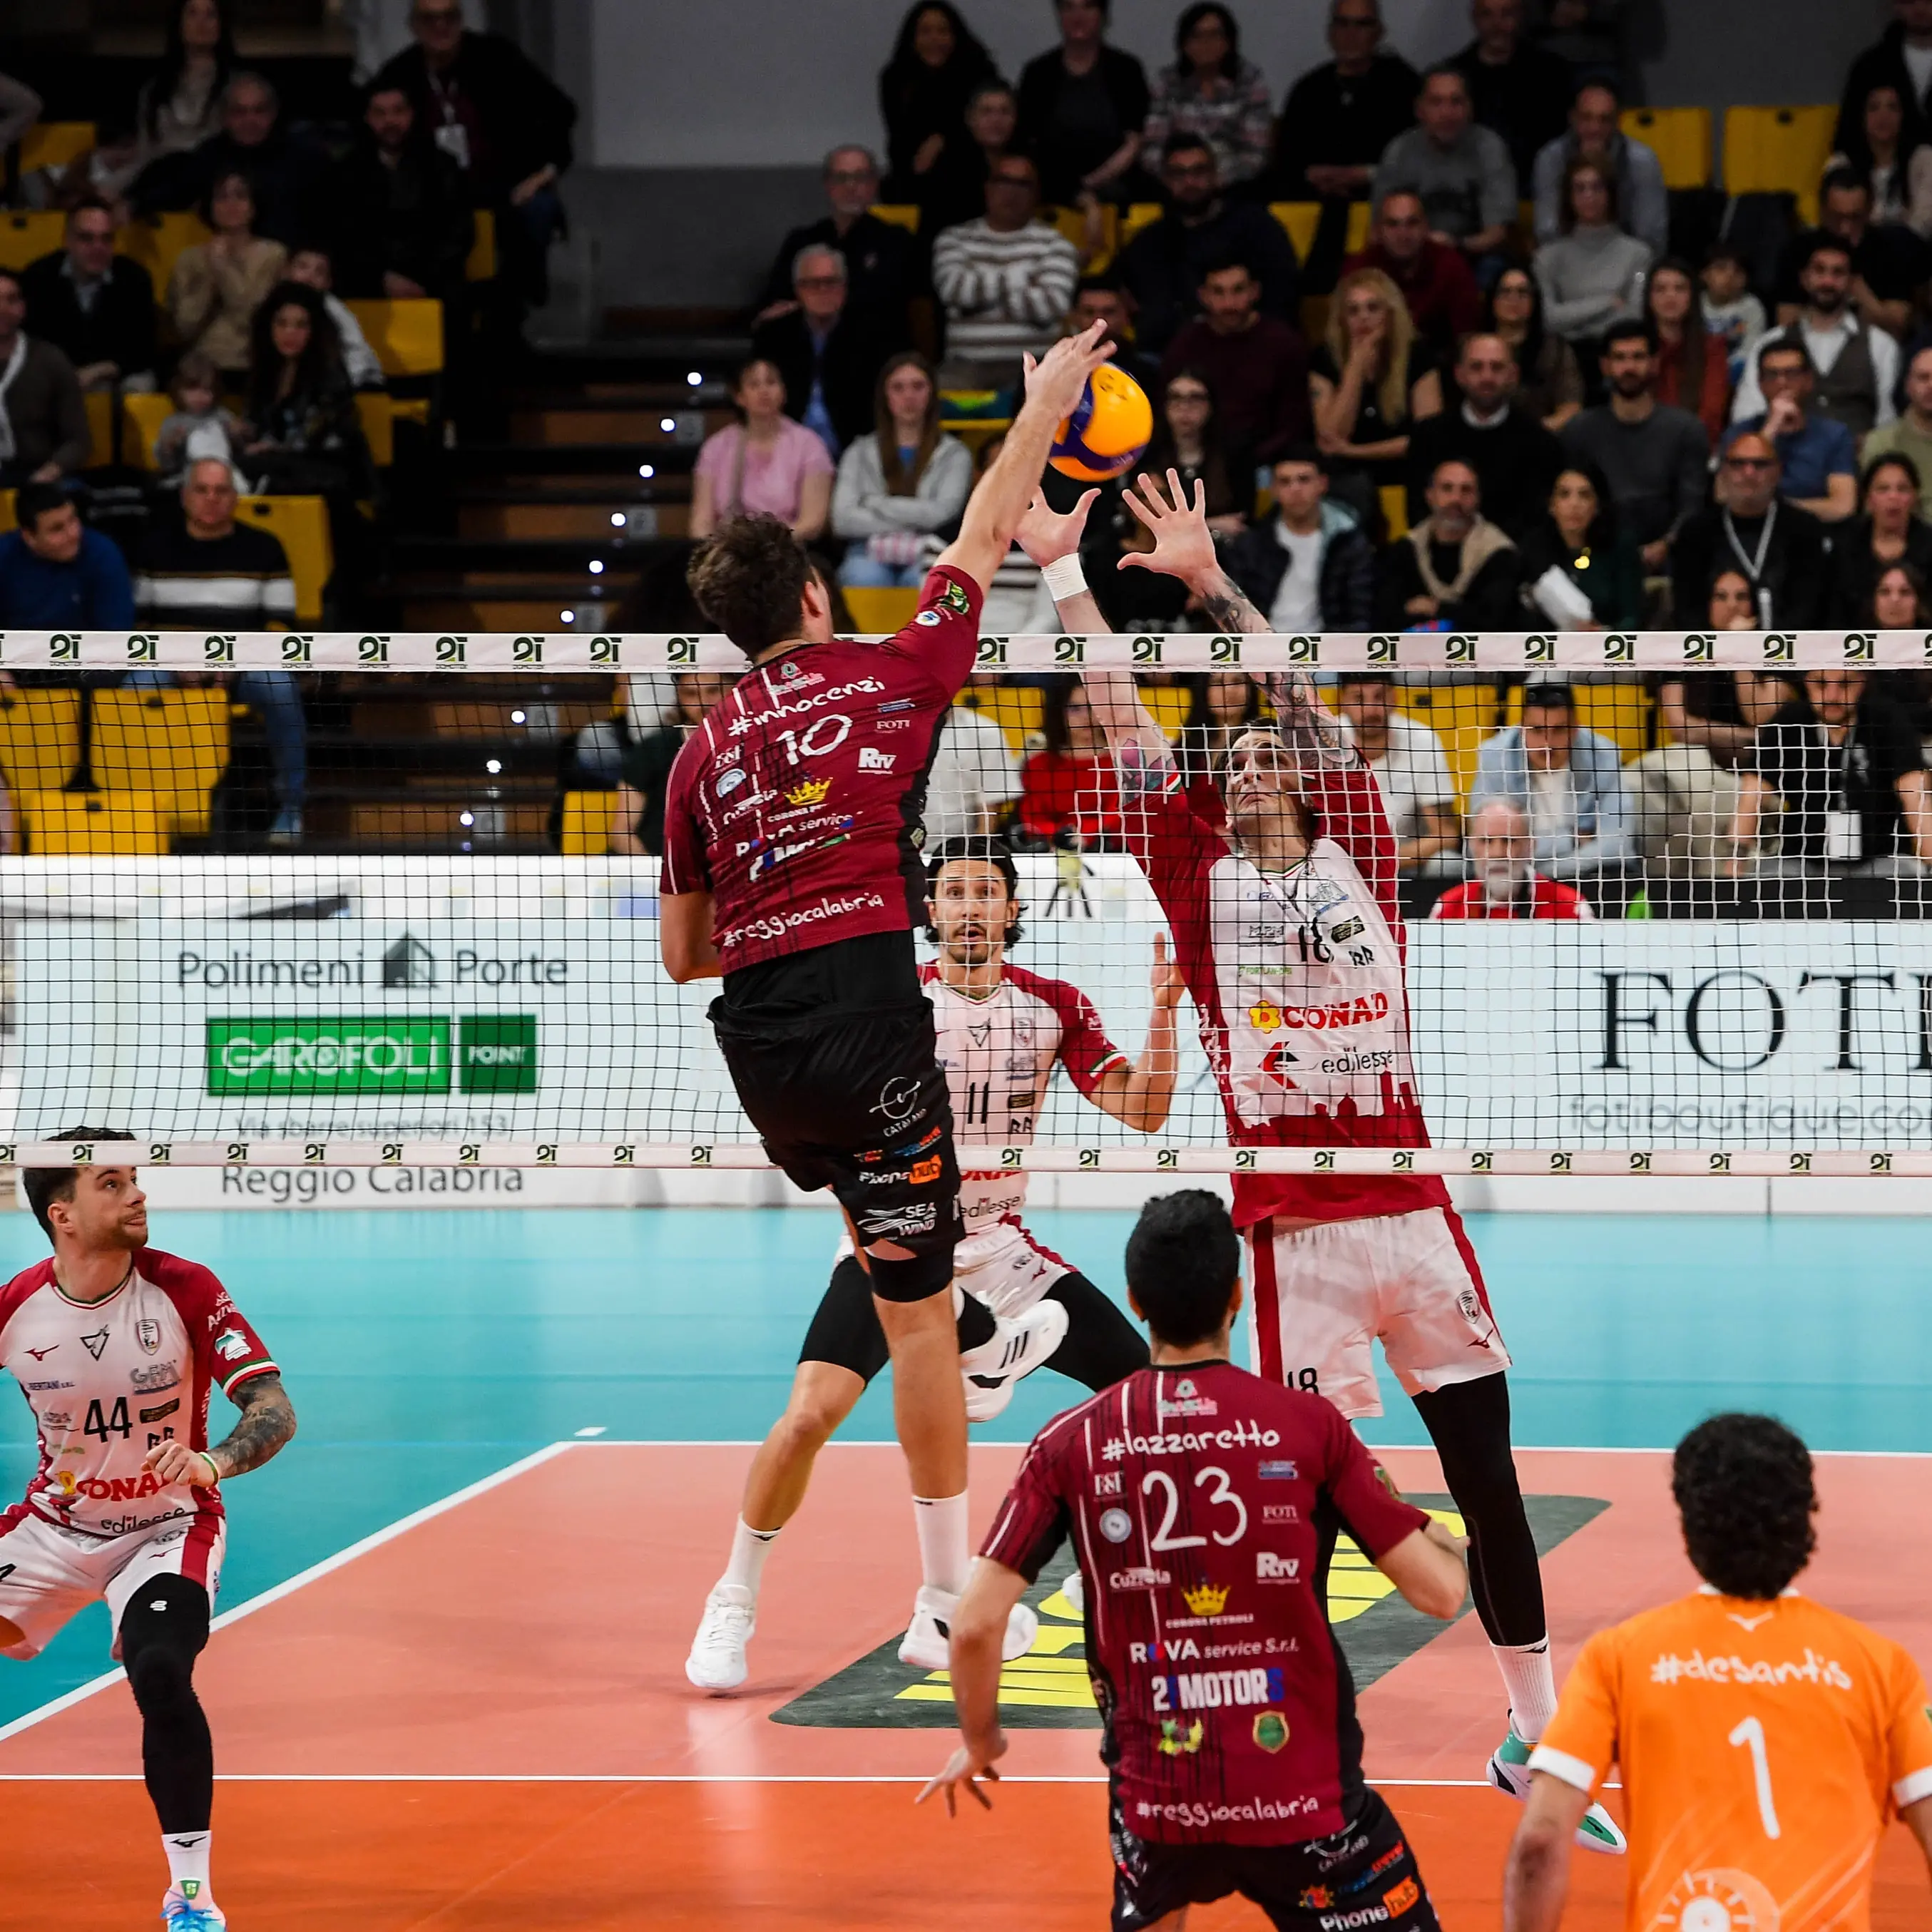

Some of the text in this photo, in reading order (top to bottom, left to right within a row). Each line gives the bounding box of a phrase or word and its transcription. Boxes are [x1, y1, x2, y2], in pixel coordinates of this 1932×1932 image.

[728, 676, 885, 737] #innocenzi
[776, 714, 852, 767] 10
[723, 892, 884, 948] #reggiocalabria
[1298, 916, 1334, 963] 18
[178, 950, 568, 988] Polimeni Porte
[1284, 992, 1389, 1029] CONAD
[221, 1036, 439, 1076] GAROFOLI
[967, 1082, 989, 1124] 11
[1569, 1099, 1932, 1136] fotiboutique.co
[222, 1165, 523, 1203] Reggio Calabria
[906, 1202, 936, 1218] SEA
[83, 1396, 133, 1443] 44
[1102, 1419, 1280, 1461] #lazzaretto
[76, 1473, 172, 1502] CONA
[1142, 1466, 1248, 1553] 23
[1204, 1640, 1262, 1660] service
[1650, 1646, 1852, 1690] #desantis
[1729, 1715, 1781, 1841] 1
[1136, 1795, 1319, 1827] #reggiocalabria
